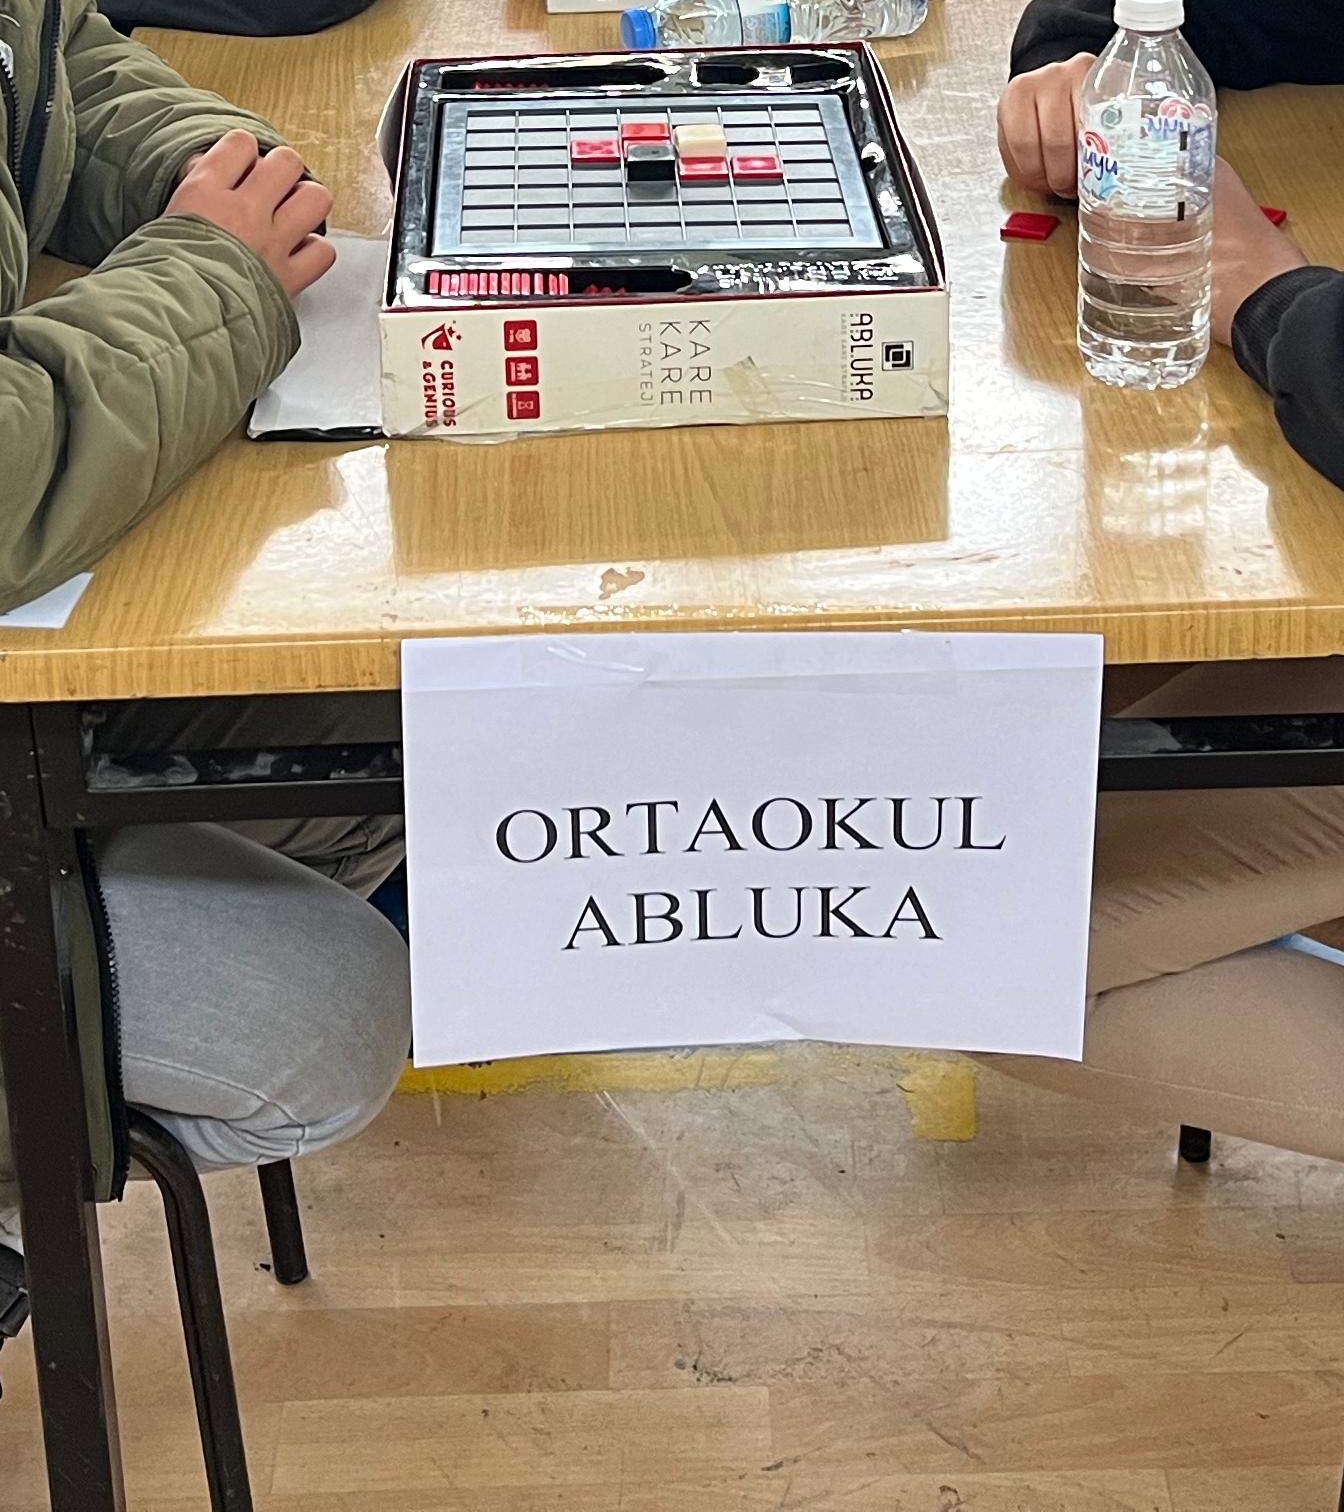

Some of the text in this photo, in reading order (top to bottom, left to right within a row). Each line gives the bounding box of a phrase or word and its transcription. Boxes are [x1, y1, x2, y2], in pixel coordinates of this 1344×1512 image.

[659, 321, 683, 406] KARE
[689, 319, 712, 404] KARE
[850, 313, 873, 402] ABLUKA
[422, 372, 439, 428] GENIUS
[440, 360, 457, 427] CURIOUS
[495, 796, 1007, 864] ORTAOKUL
[560, 885, 943, 951] ABLUKA
